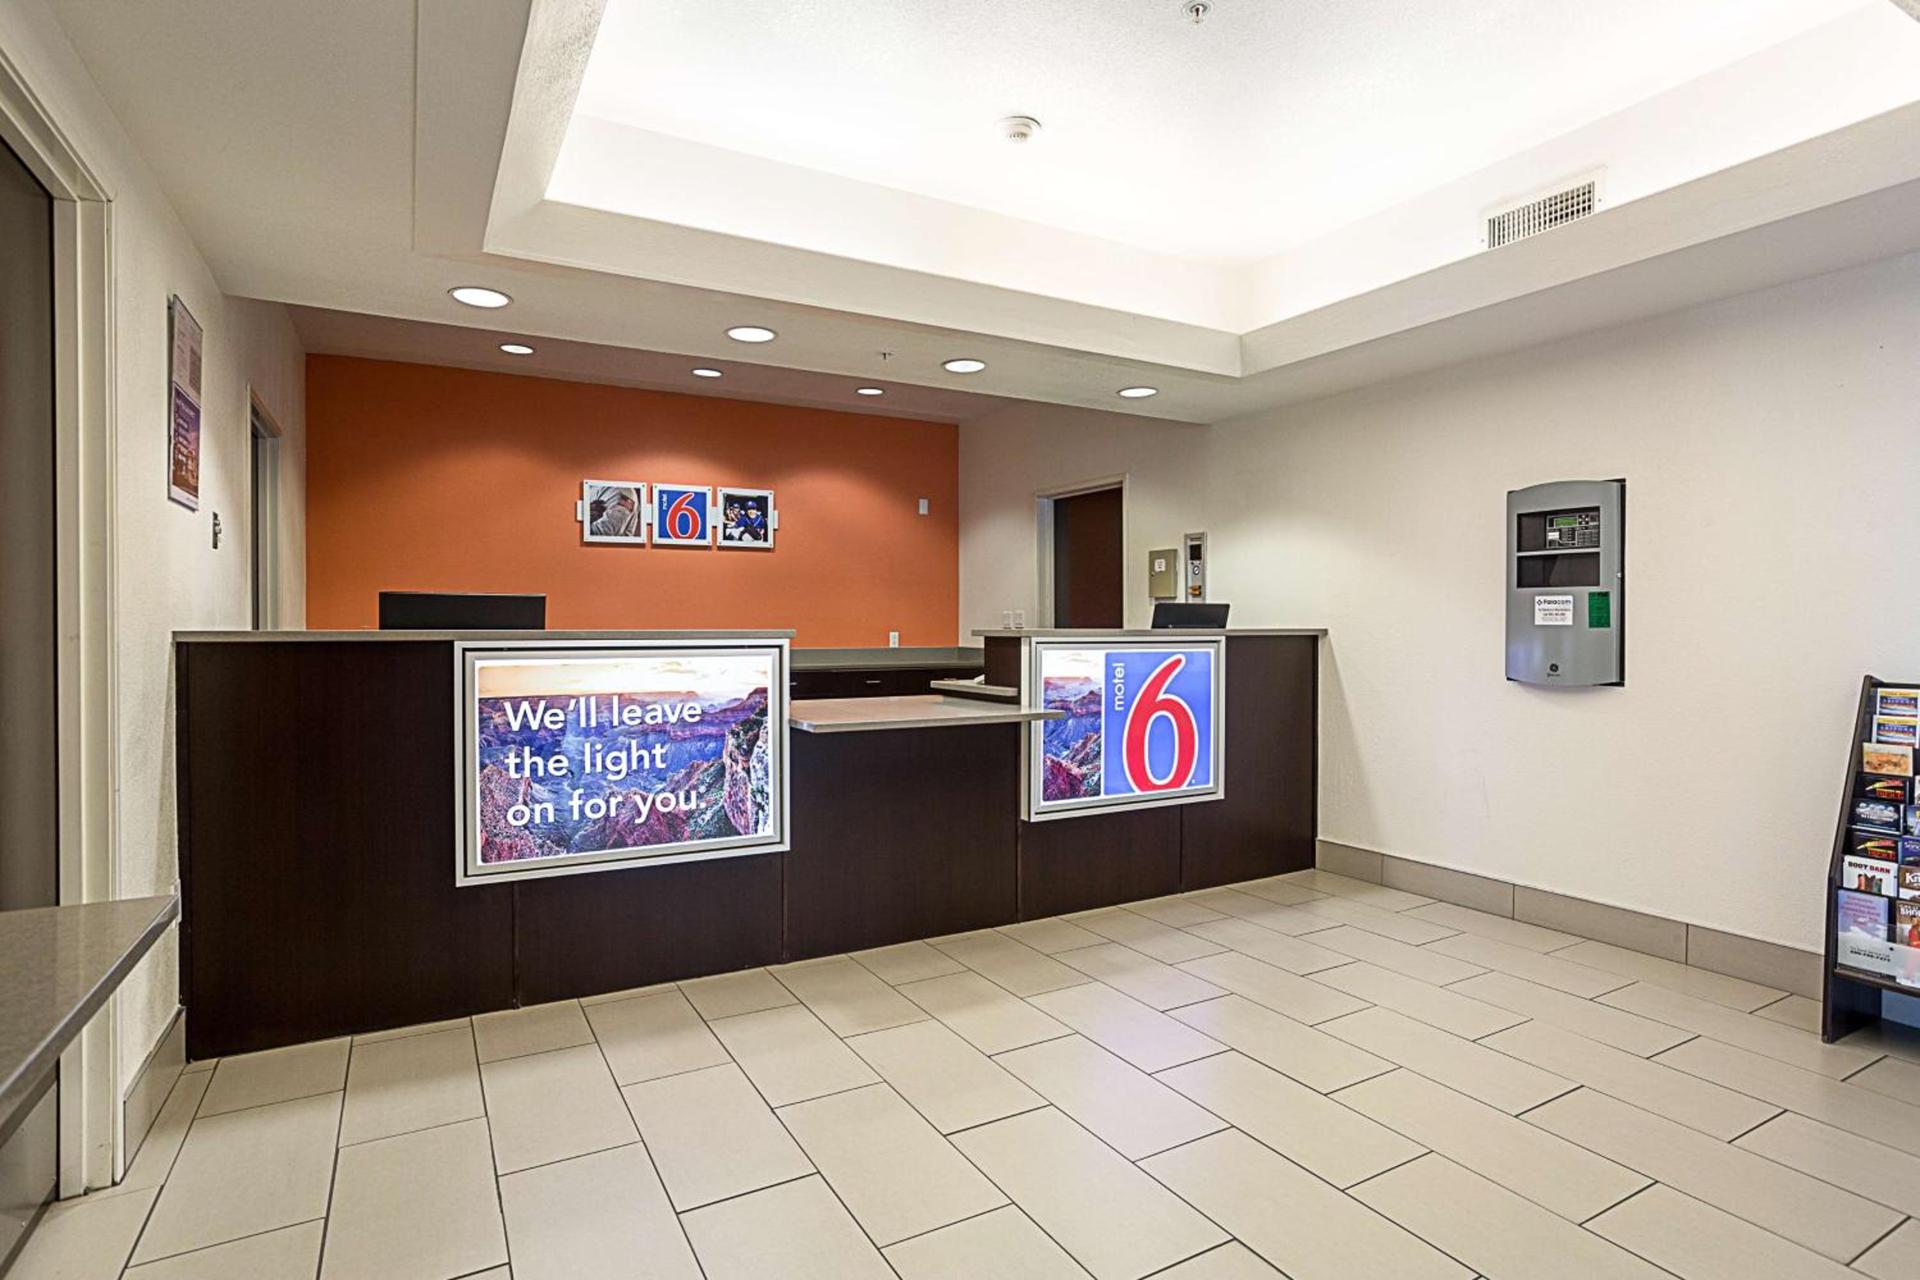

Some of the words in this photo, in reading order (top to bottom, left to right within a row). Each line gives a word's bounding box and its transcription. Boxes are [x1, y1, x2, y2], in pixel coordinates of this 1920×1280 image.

[667, 492, 701, 540] 6
[503, 695, 597, 731] We'll
[612, 695, 702, 726] leave
[1112, 662, 1125, 711] motel
[1122, 653, 1199, 793] 6
[504, 745, 570, 779] the
[584, 742, 666, 780] light
[506, 801, 555, 827] on
[569, 787, 625, 821] for
